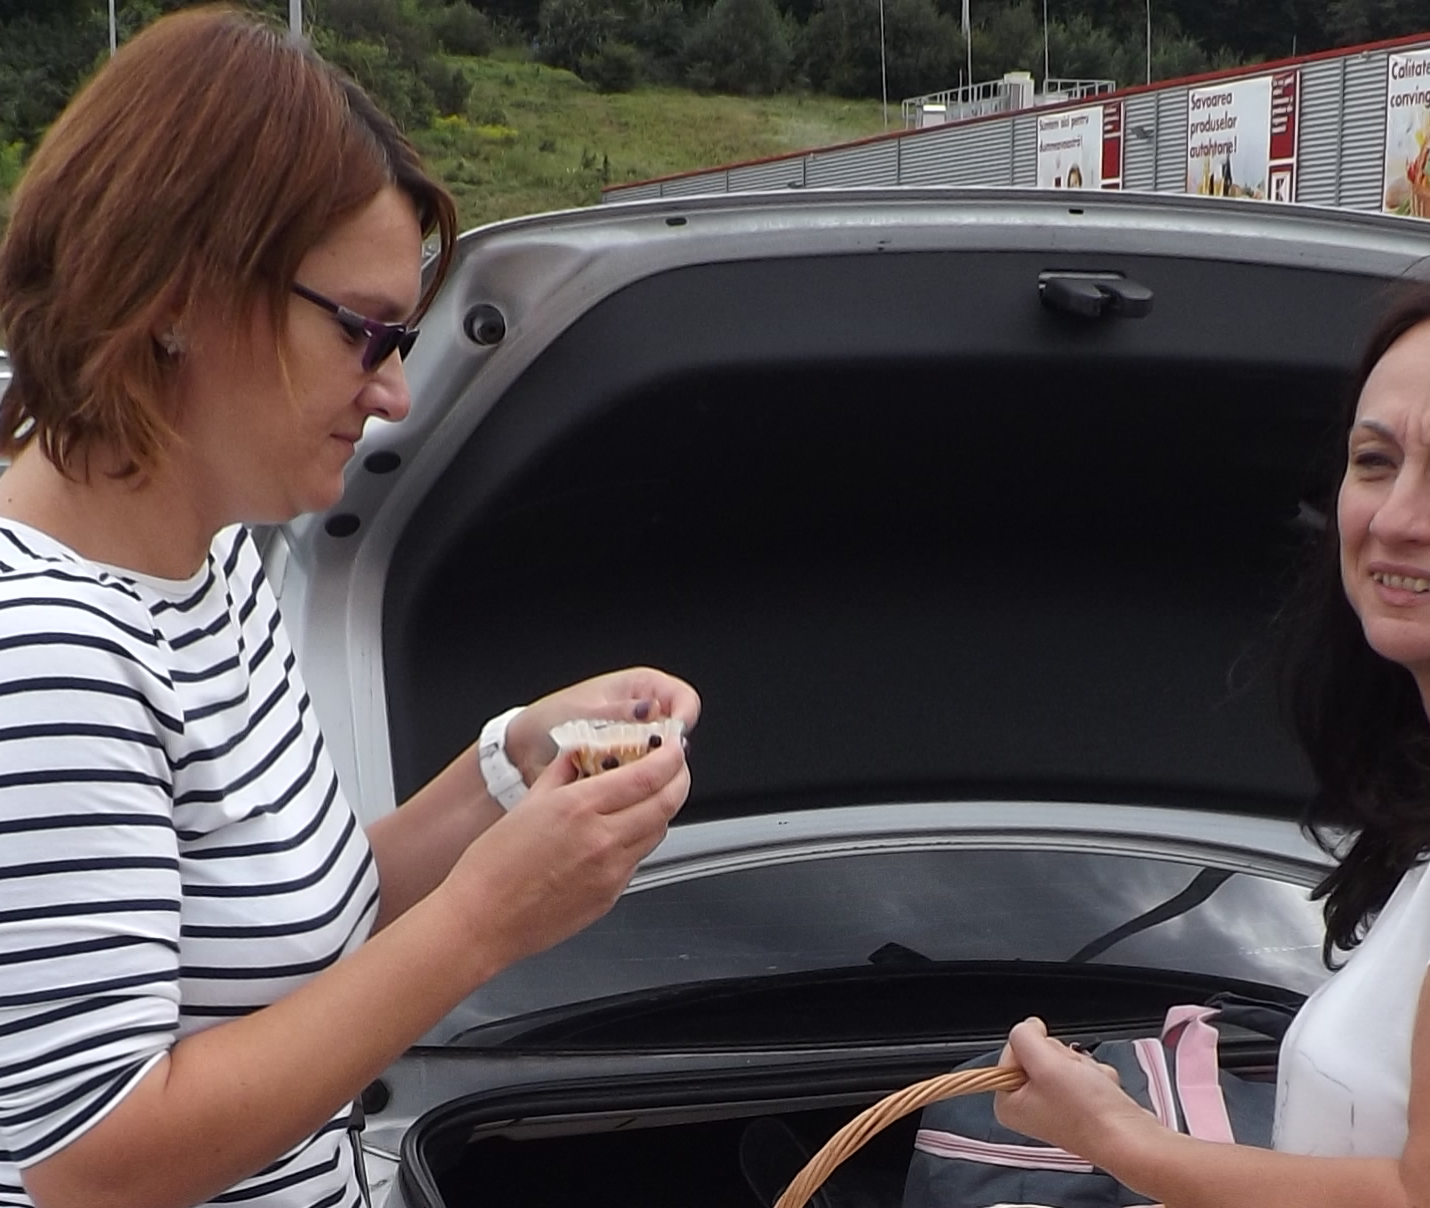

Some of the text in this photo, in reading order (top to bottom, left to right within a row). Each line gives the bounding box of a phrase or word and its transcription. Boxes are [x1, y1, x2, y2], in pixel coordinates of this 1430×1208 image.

[1190, 92, 1233, 111] Savoarea
[1190, 110, 1238, 137] produselor
[1189, 135, 1237, 159] autohtone!
